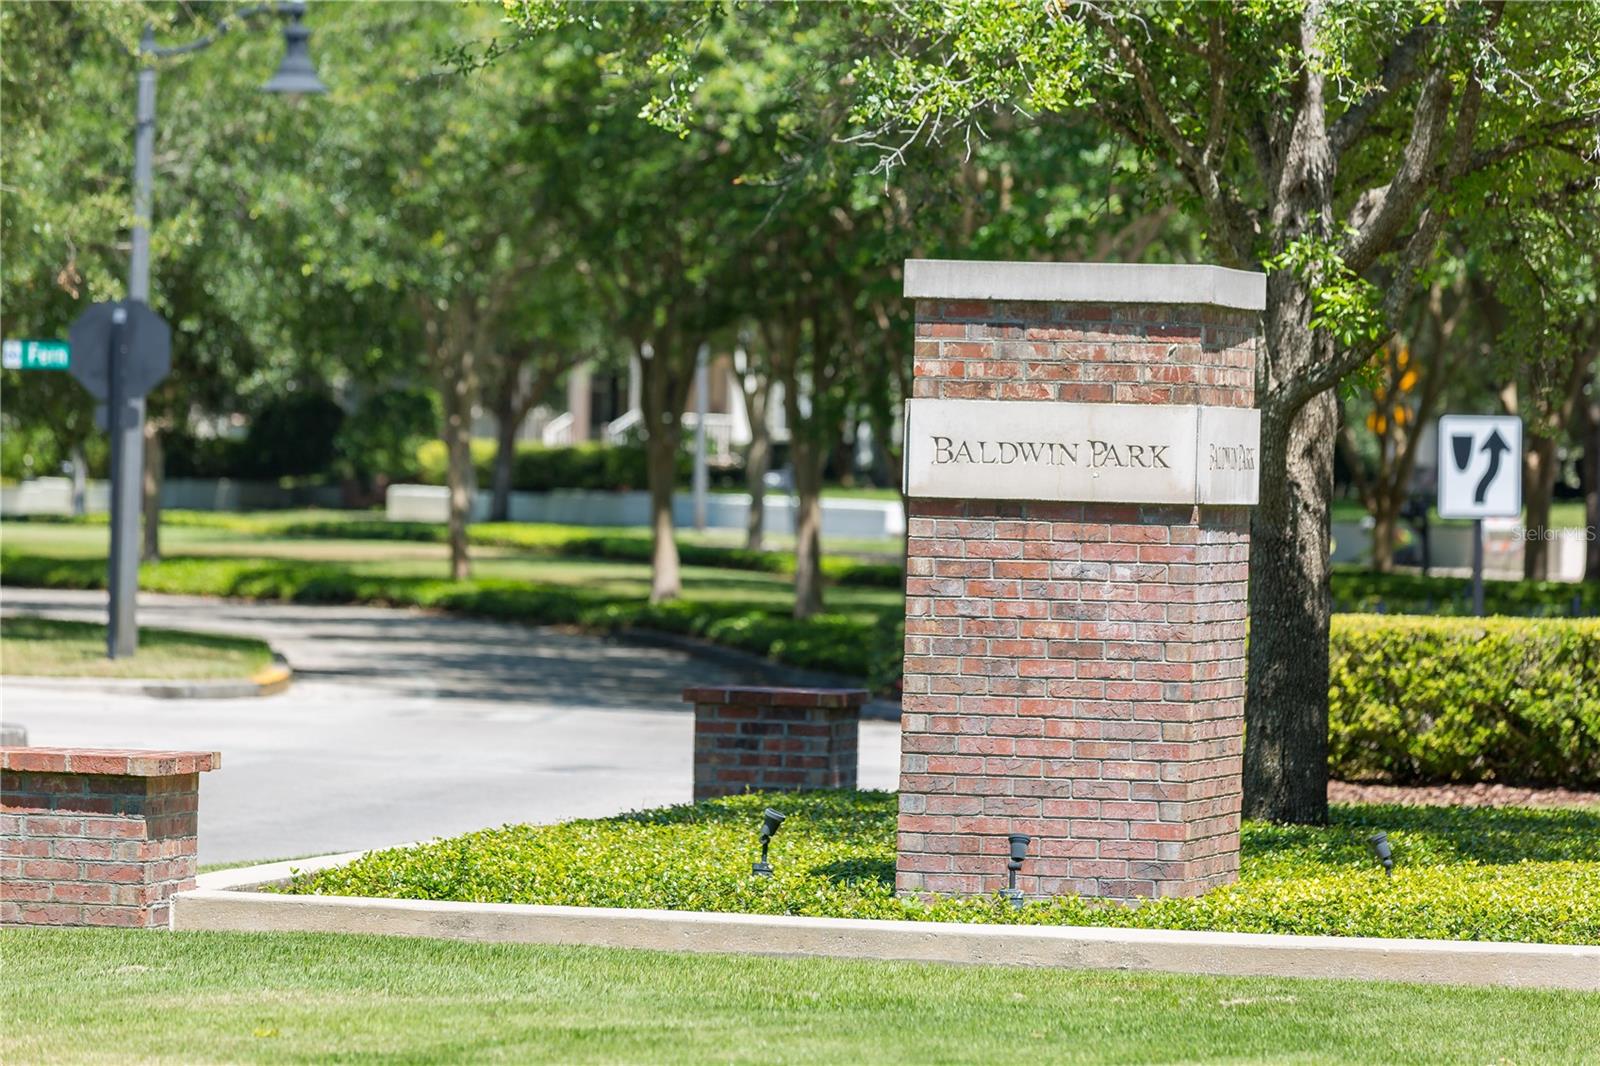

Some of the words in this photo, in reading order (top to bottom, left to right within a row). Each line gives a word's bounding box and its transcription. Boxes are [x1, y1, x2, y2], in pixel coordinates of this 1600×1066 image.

[930, 435, 1079, 466] BALDWIN
[1086, 439, 1171, 469] PARK
[1209, 443, 1238, 470] BALDWIN
[1238, 444, 1255, 471] PARK
